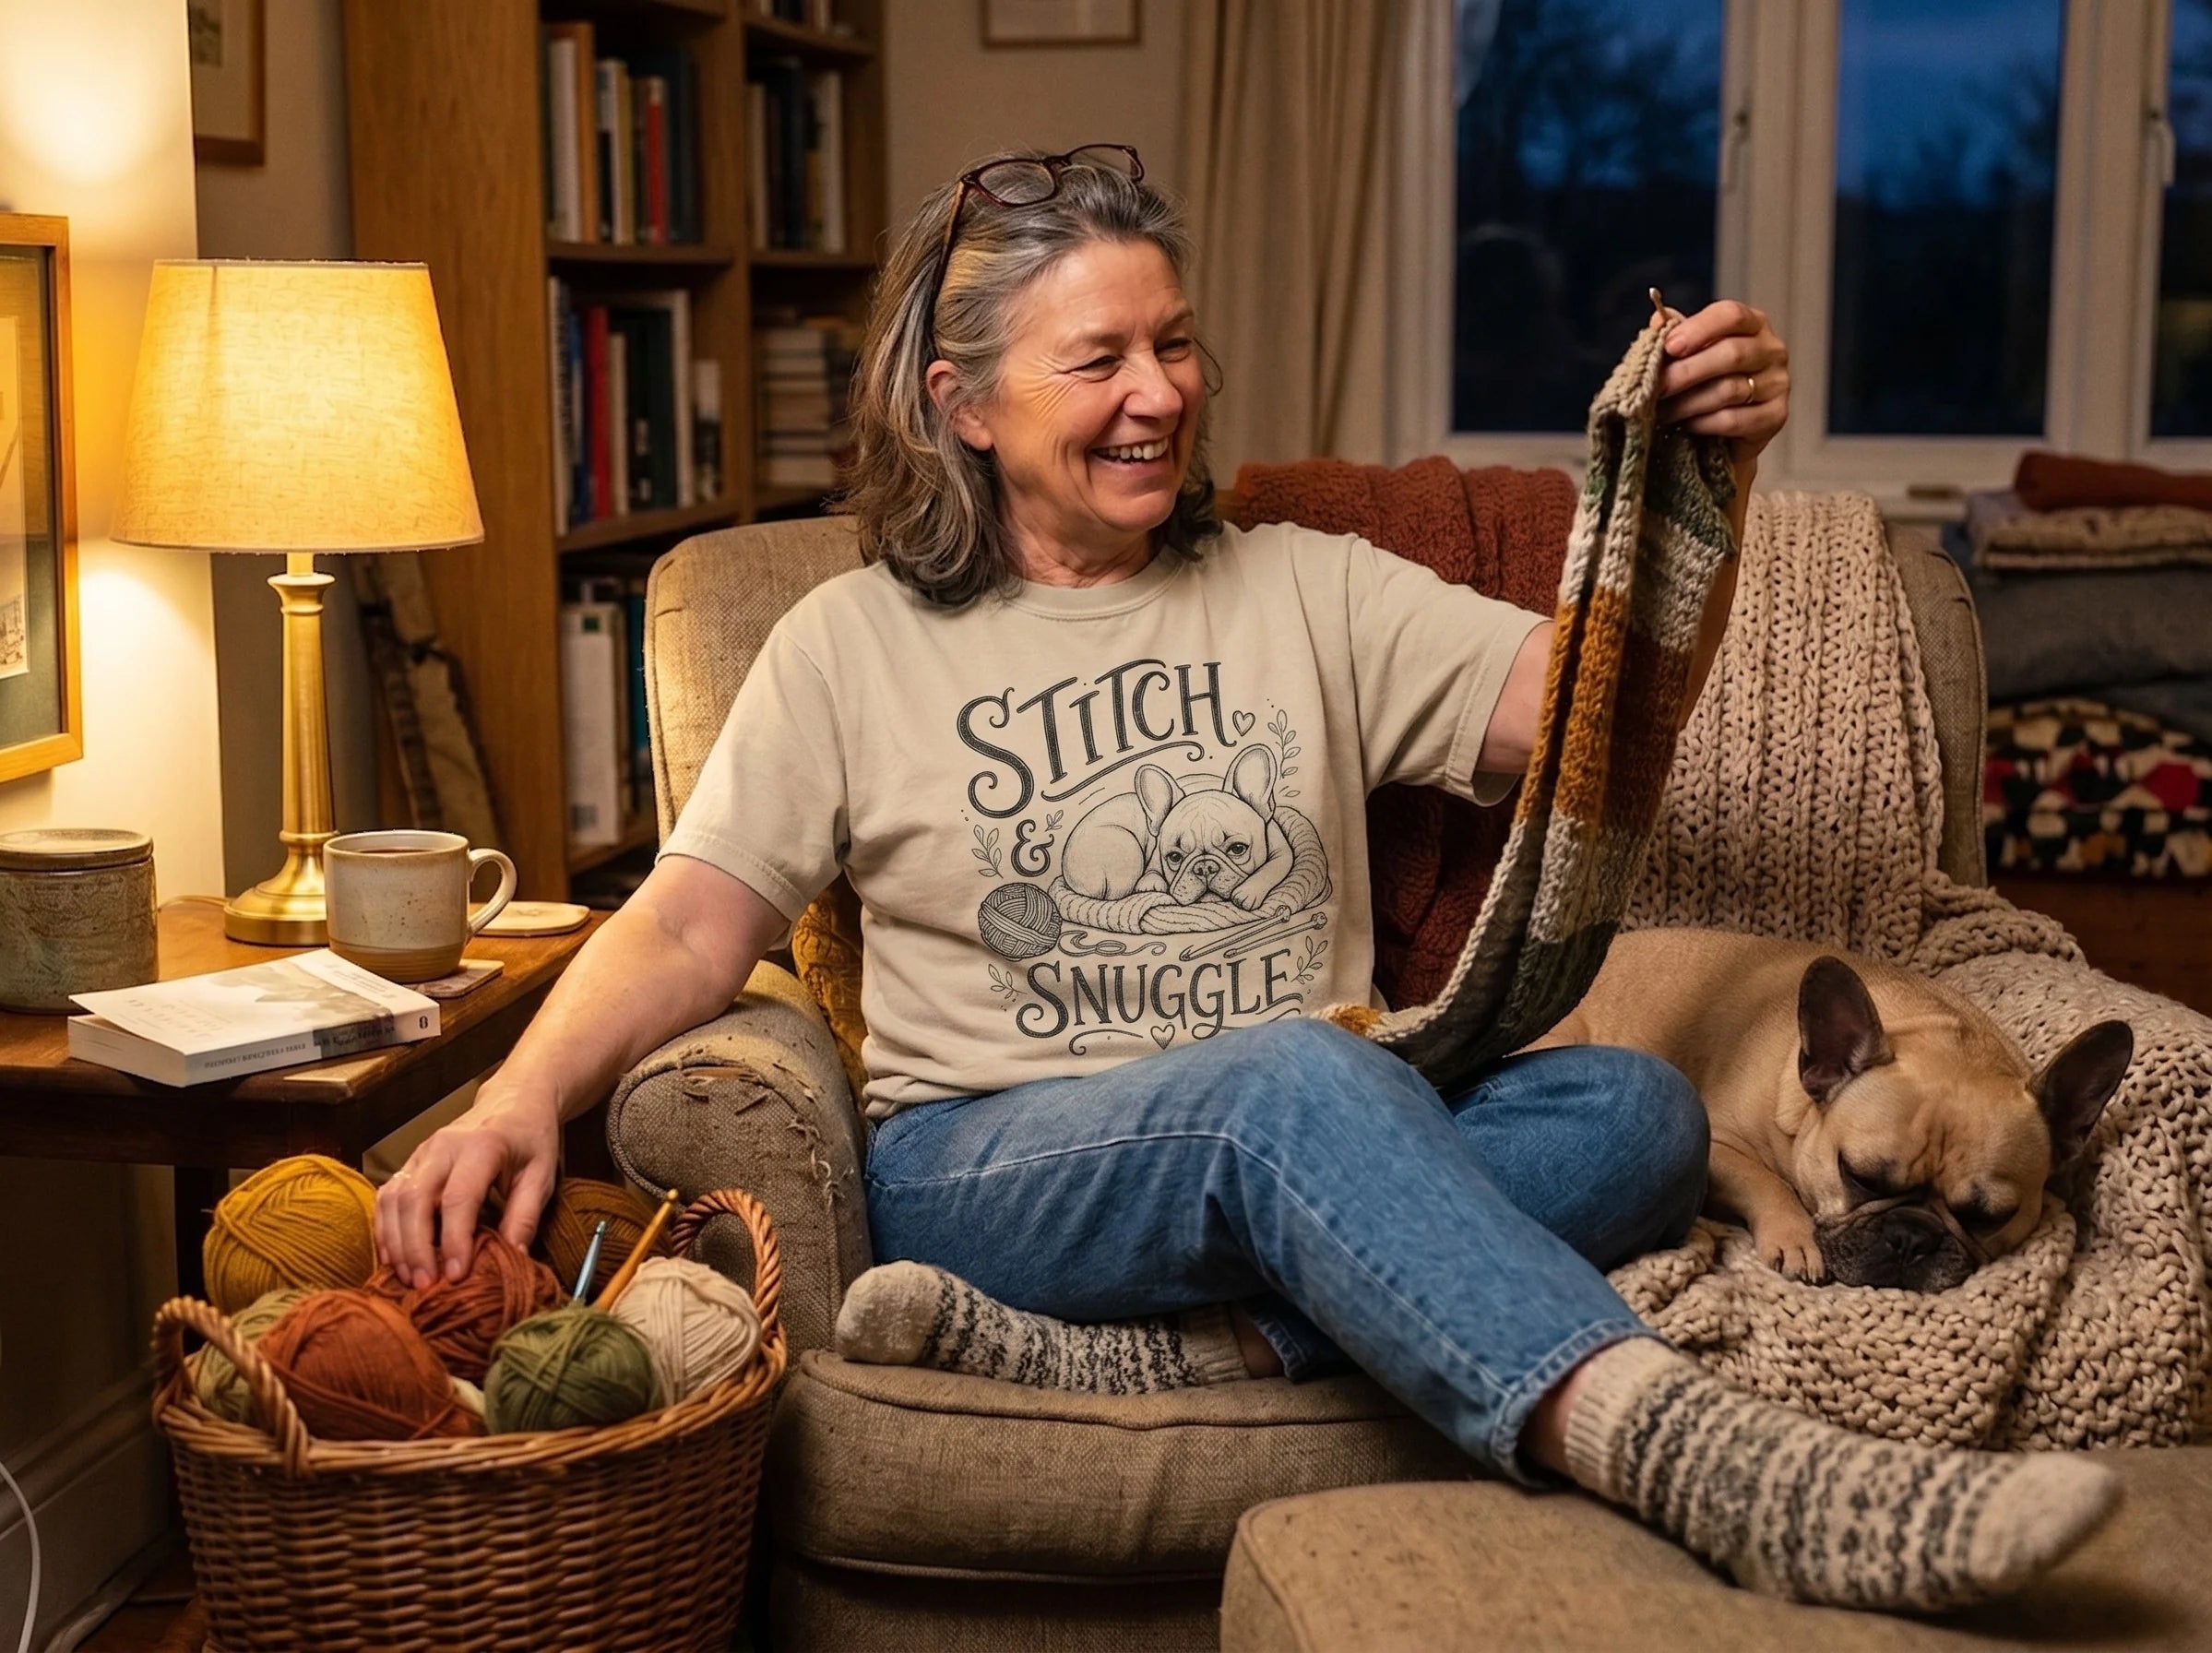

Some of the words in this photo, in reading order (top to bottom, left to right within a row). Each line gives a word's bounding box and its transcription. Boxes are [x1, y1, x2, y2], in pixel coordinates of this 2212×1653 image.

[957, 659, 1237, 818] STITCH
[1010, 820, 1055, 877] &
[1016, 949, 1303, 1041] SNUGGLE
